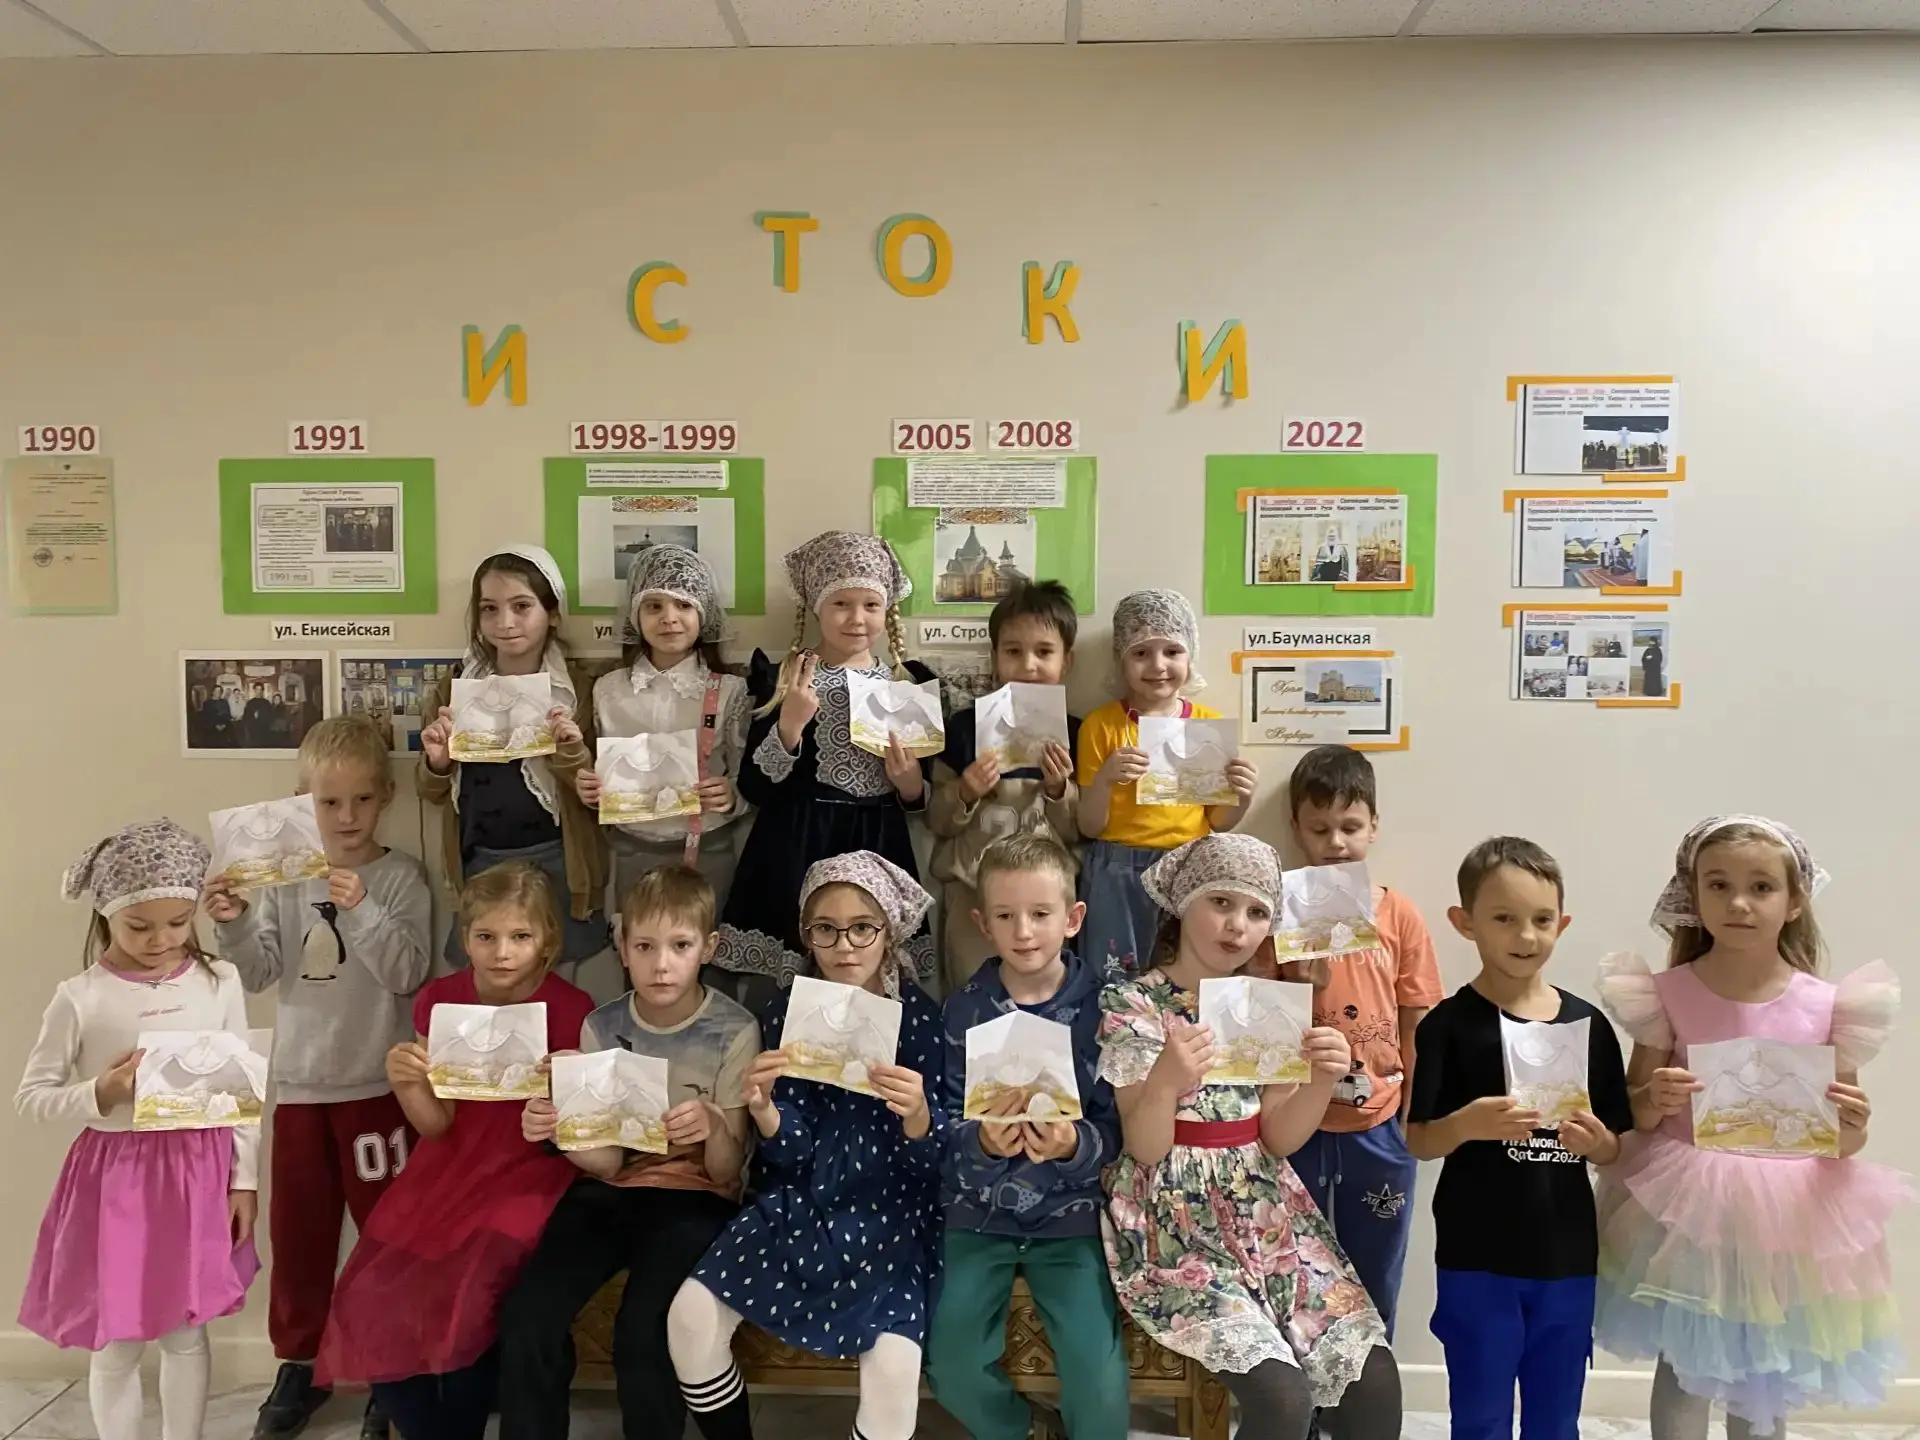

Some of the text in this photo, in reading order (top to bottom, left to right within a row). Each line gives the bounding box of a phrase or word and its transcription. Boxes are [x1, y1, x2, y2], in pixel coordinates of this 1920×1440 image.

[24, 426, 95, 451] 1990
[294, 425, 365, 450] 1991
[574, 424, 736, 450] 1998-1999
[898, 424, 971, 450] 2005
[998, 421, 1072, 447] 2008
[1287, 421, 1363, 447] 2022
[275, 622, 390, 639] ул. Енисейская
[924, 625, 990, 641] ул. Стро
